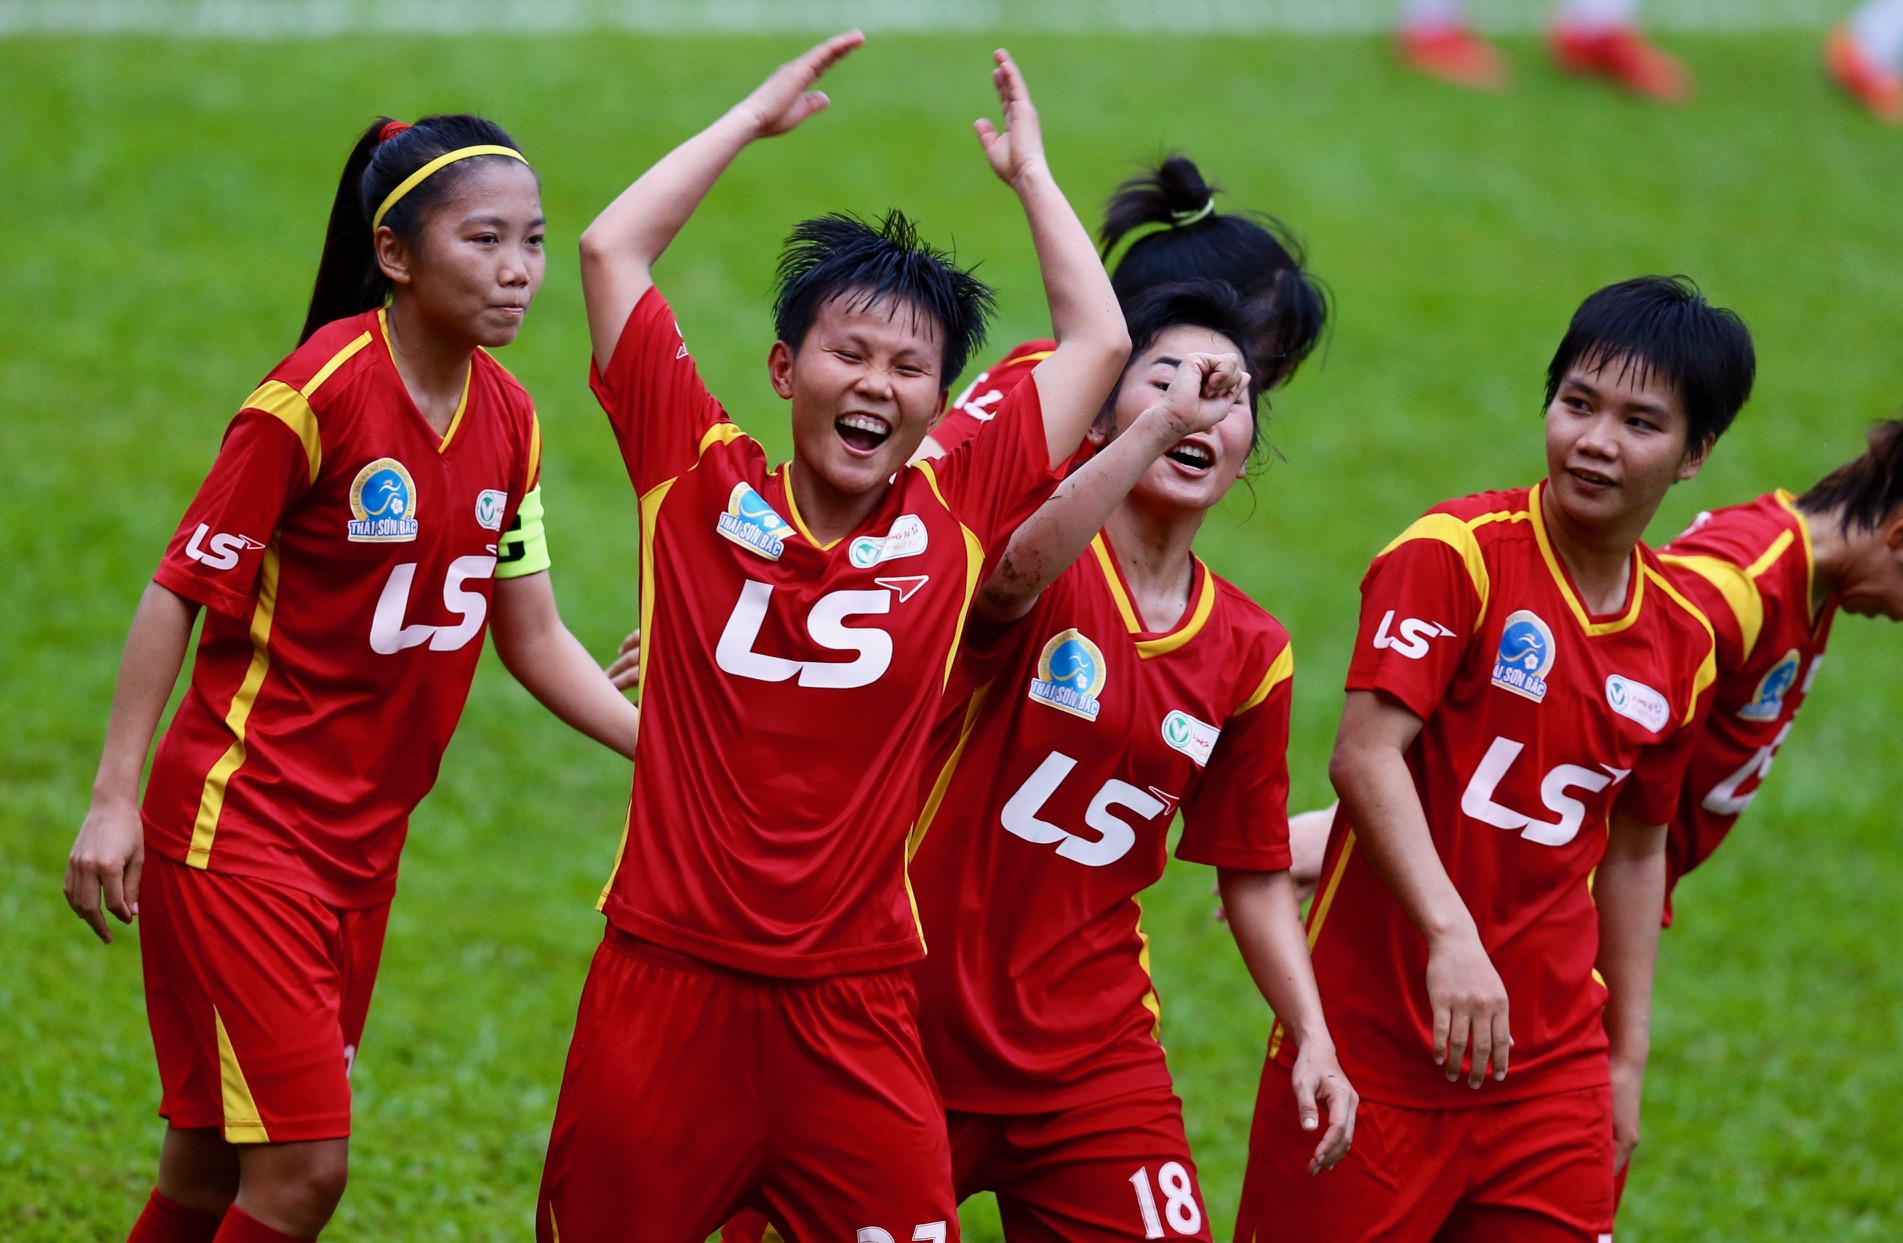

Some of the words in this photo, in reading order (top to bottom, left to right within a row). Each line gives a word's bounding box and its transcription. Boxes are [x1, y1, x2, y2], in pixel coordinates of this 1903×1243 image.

[185, 523, 246, 570] LS
[351, 518, 375, 535] THÁI
[720, 515, 742, 534] THÁI
[370, 562, 497, 655] LS
[715, 579, 893, 689] LS
[1373, 610, 1442, 660] LS
[1032, 681, 1056, 699] THÁI
[1001, 750, 1165, 867] LS
[1461, 736, 1611, 846] LS
[1129, 1161, 1202, 1239] 18
